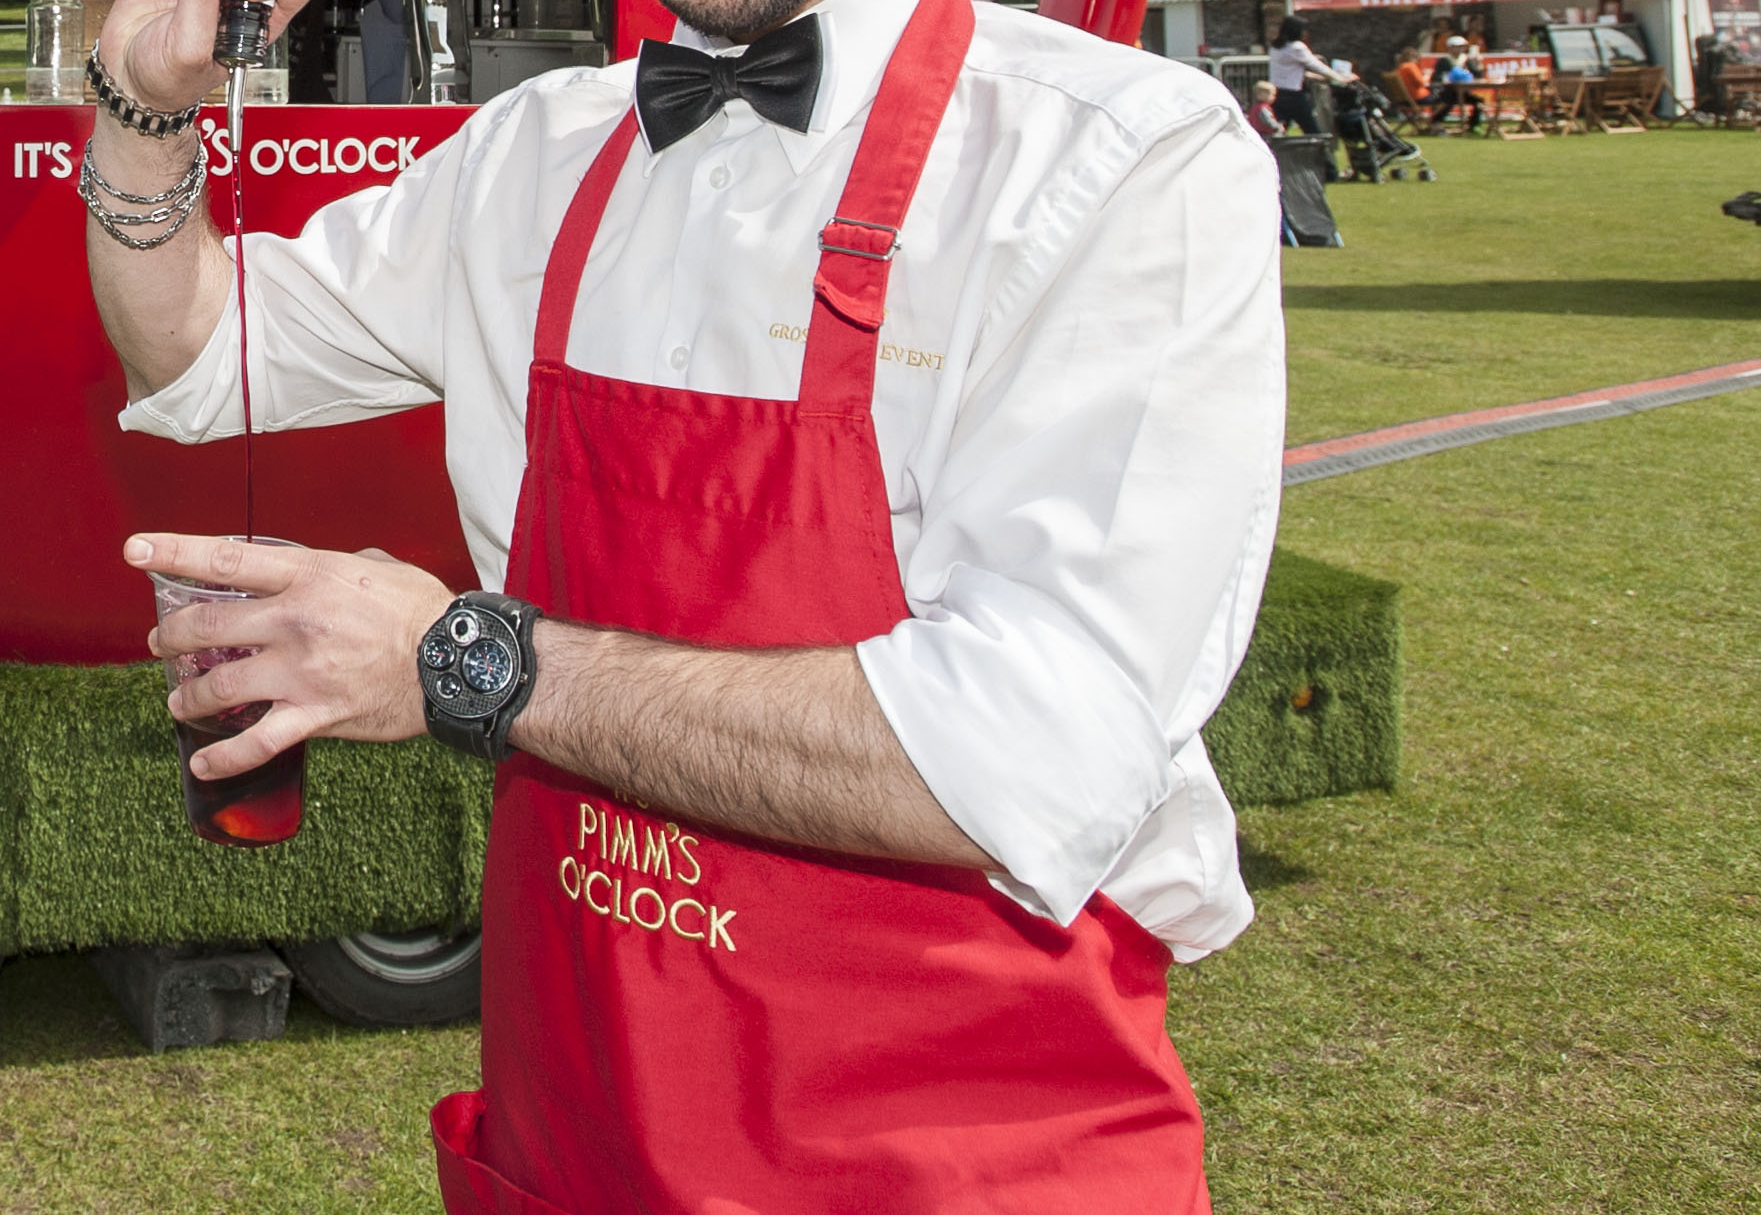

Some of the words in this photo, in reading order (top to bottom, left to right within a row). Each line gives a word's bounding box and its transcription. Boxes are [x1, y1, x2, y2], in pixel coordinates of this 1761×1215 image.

[13, 142, 72, 179] IT'S
[249, 136, 421, 176] O'CLOCK
[768, 322, 809, 344] GROS
[578, 802, 702, 886] PIMM'S
[559, 856, 738, 952] O'CLOCK
